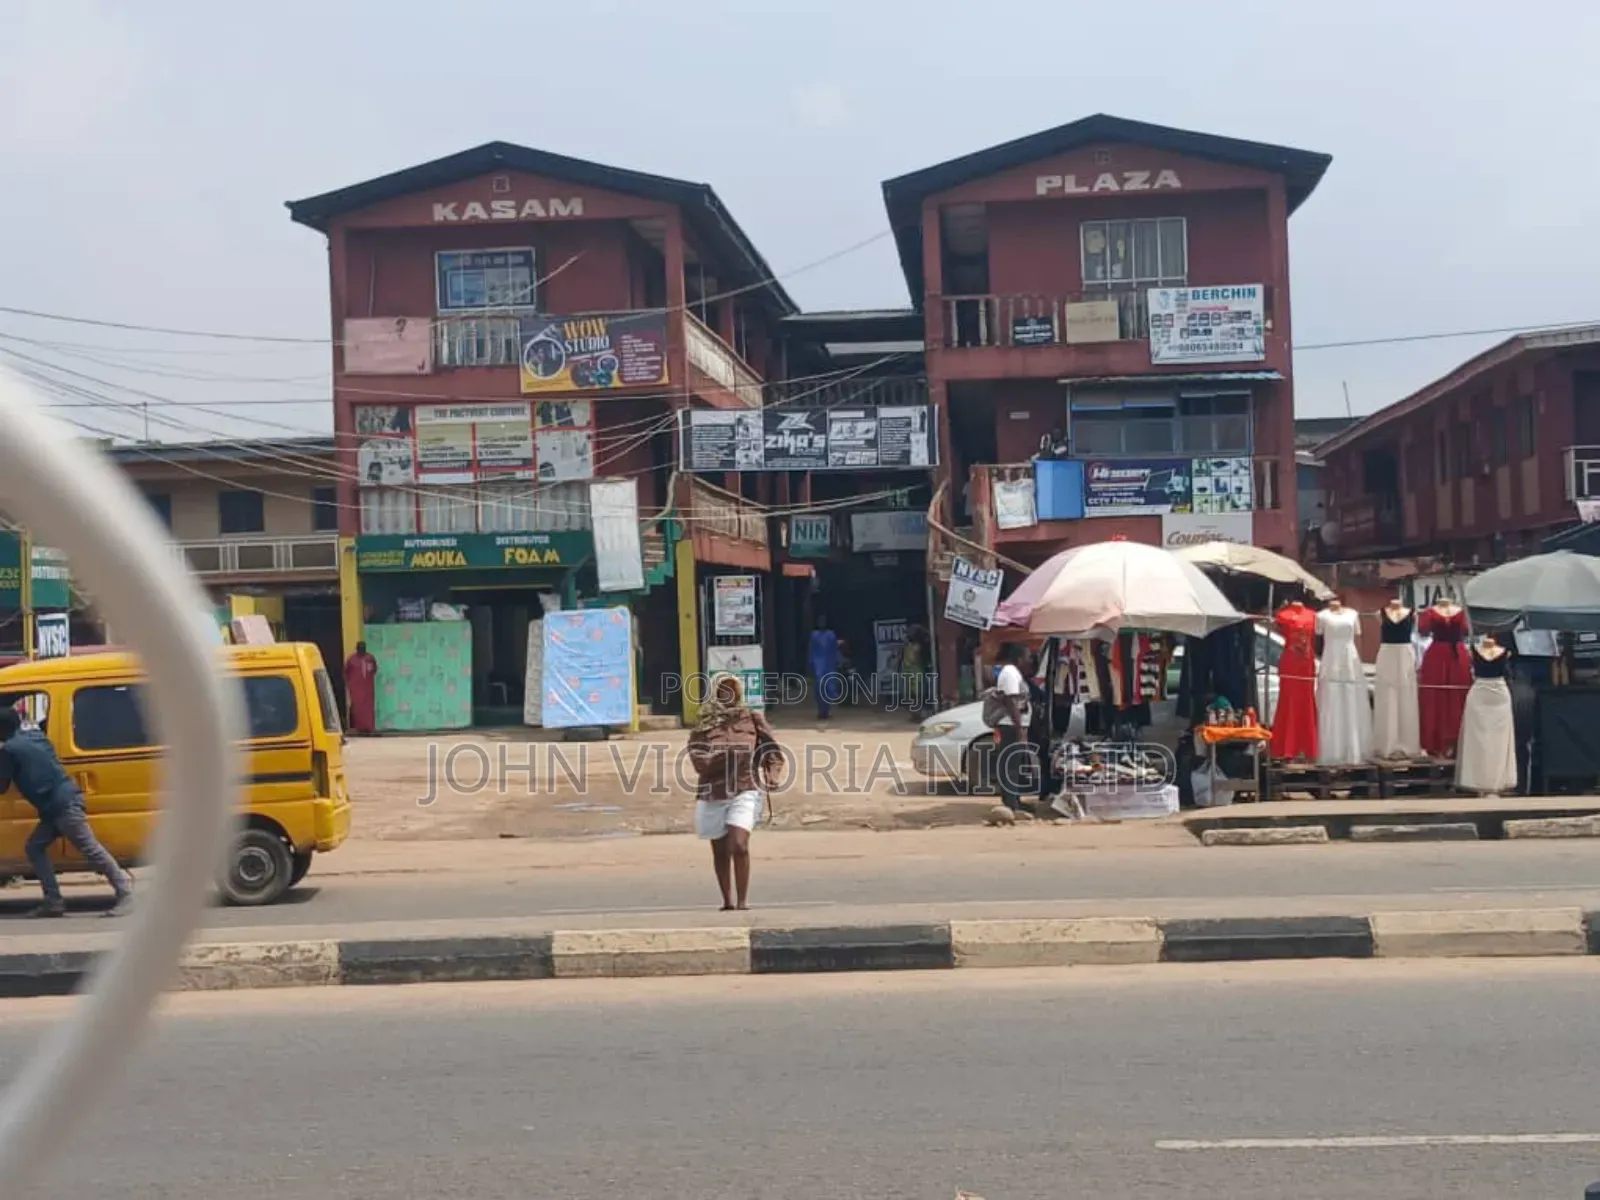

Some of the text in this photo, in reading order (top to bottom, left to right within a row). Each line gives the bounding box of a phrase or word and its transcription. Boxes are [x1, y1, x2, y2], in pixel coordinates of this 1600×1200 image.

[1036, 170, 1182, 196] PLAZA
[432, 198, 585, 222] KASAM
[1191, 287, 1257, 301] BERCHIN
[563, 319, 607, 340] WOW
[564, 336, 610, 354] STUDIO
[794, 519, 828, 541] NIN
[411, 551, 468, 568] MOUKA
[504, 547, 561, 565] FOAM
[953, 559, 1000, 587] NYSC
[38, 624, 67, 656] NYSC
